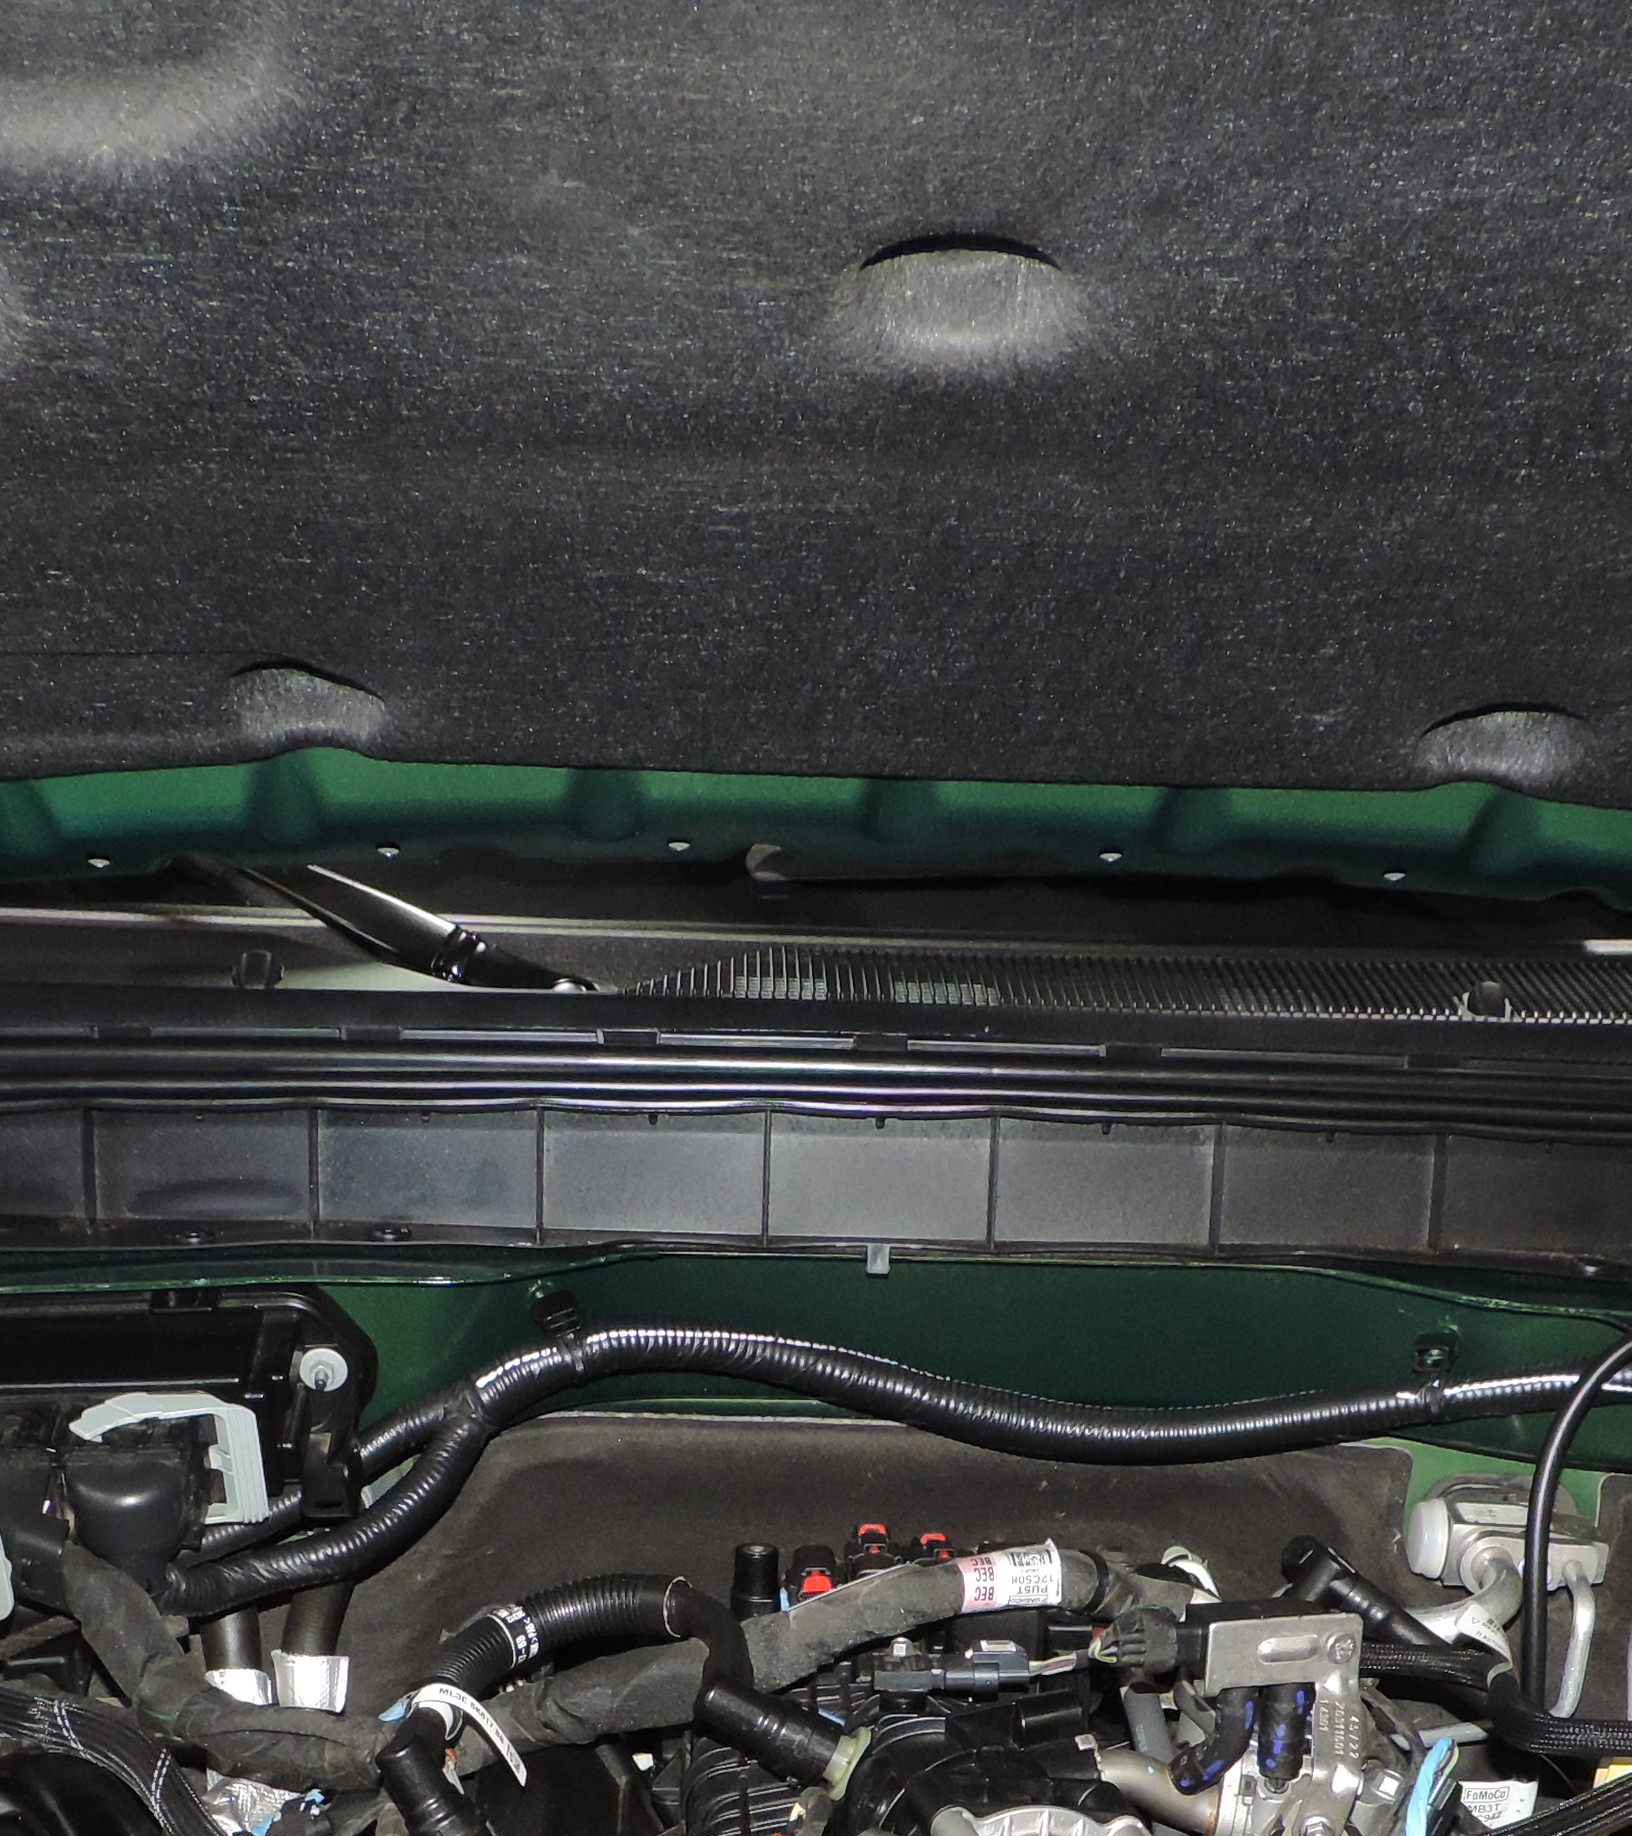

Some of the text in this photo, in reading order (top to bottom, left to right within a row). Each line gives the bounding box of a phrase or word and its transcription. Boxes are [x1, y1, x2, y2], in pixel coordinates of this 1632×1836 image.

[971, 1556, 992, 1566] BEC
[973, 1567, 995, 1582] BEC
[973, 1586, 995, 1602] BEC
[1466, 1789, 1507, 1800] FoMoCo
